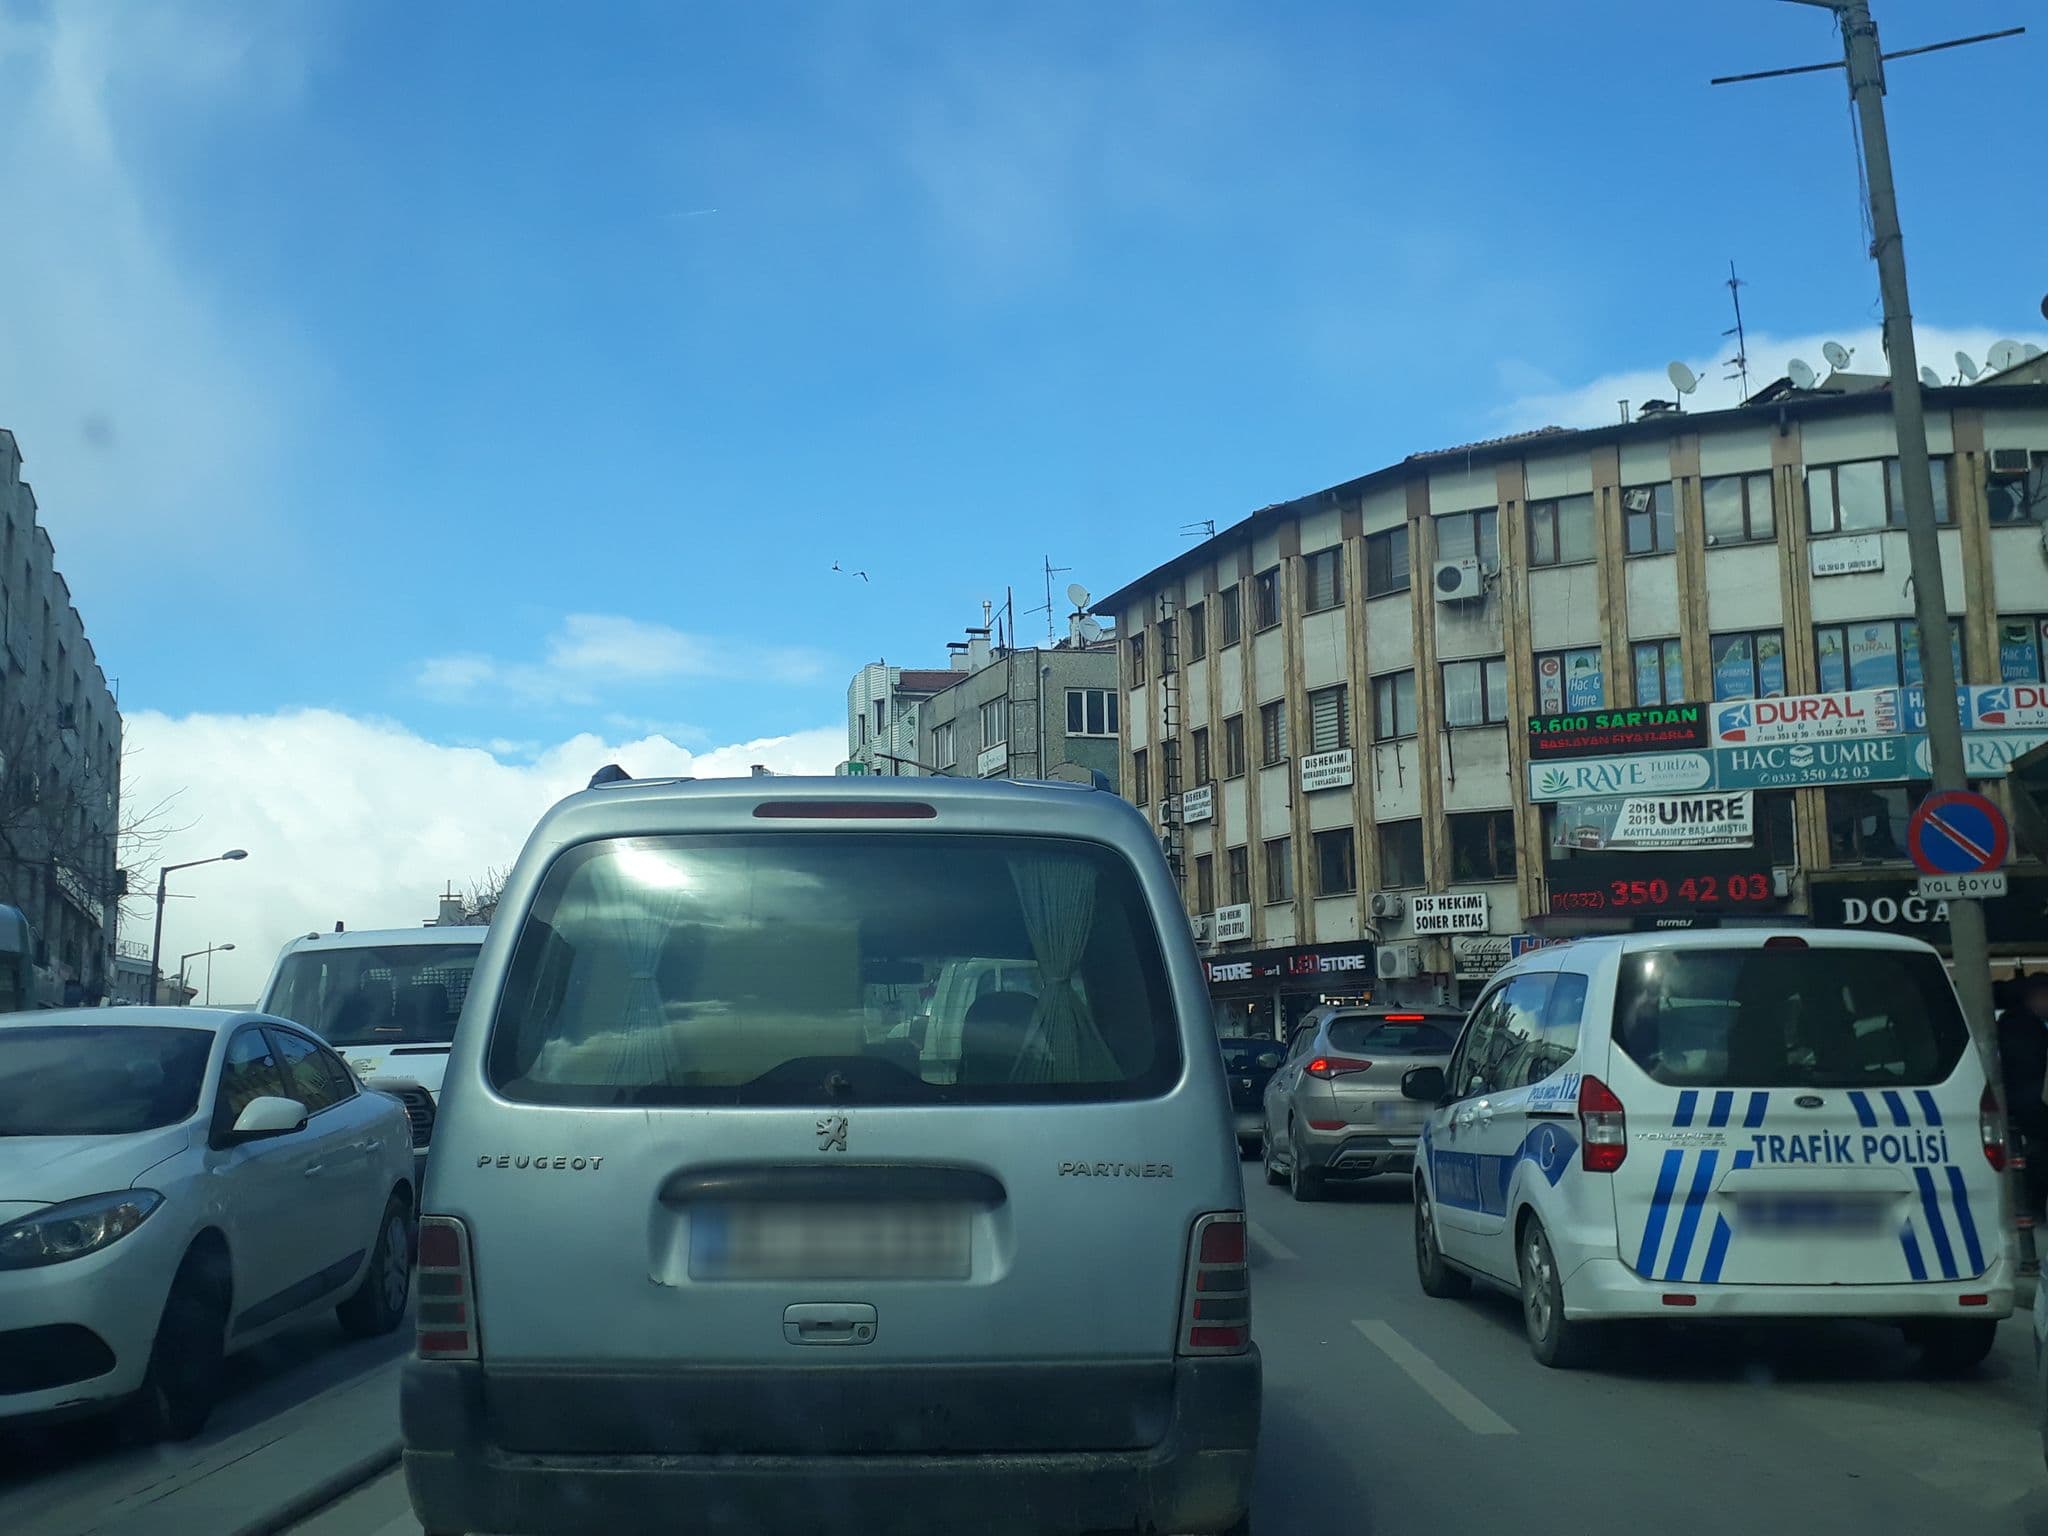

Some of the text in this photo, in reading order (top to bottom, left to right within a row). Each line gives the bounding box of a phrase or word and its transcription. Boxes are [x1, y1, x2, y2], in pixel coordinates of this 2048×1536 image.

[1570, 677, 1588, 691] Hac
[1571, 693, 1597, 707] Umre
[1756, 696, 1864, 725] DURAL
[1529, 708, 1698, 735] 3.600 SAR'DAN
[1732, 741, 1896, 771] HAC UMRE
[1576, 763, 1646, 792] RAYE
[1800, 769, 1826, 781] 350
[1831, 768, 1848, 779] 42
[1853, 766, 1870, 778] 03
[1629, 803, 1655, 814] 2018
[1658, 797, 1745, 825] UMRE
[1629, 815, 1656, 825] 2019
[1610, 878, 1668, 906] 350
[1678, 877, 1719, 901] 42
[1728, 873, 1768, 901] 03
[1923, 879, 2002, 893] YOL BOYU
[1416, 913, 1484, 930] SONER ERTAŞ
[1212, 962, 1253, 983] STORE
[1320, 954, 1367, 973] STORE
[1560, 1072, 1580, 1100] 112
[1752, 1129, 1949, 1164] TRAFİK POLİSİ
[477, 1155, 604, 1171] PEUGEOT
[1058, 1162, 1174, 1178] PARTNER
